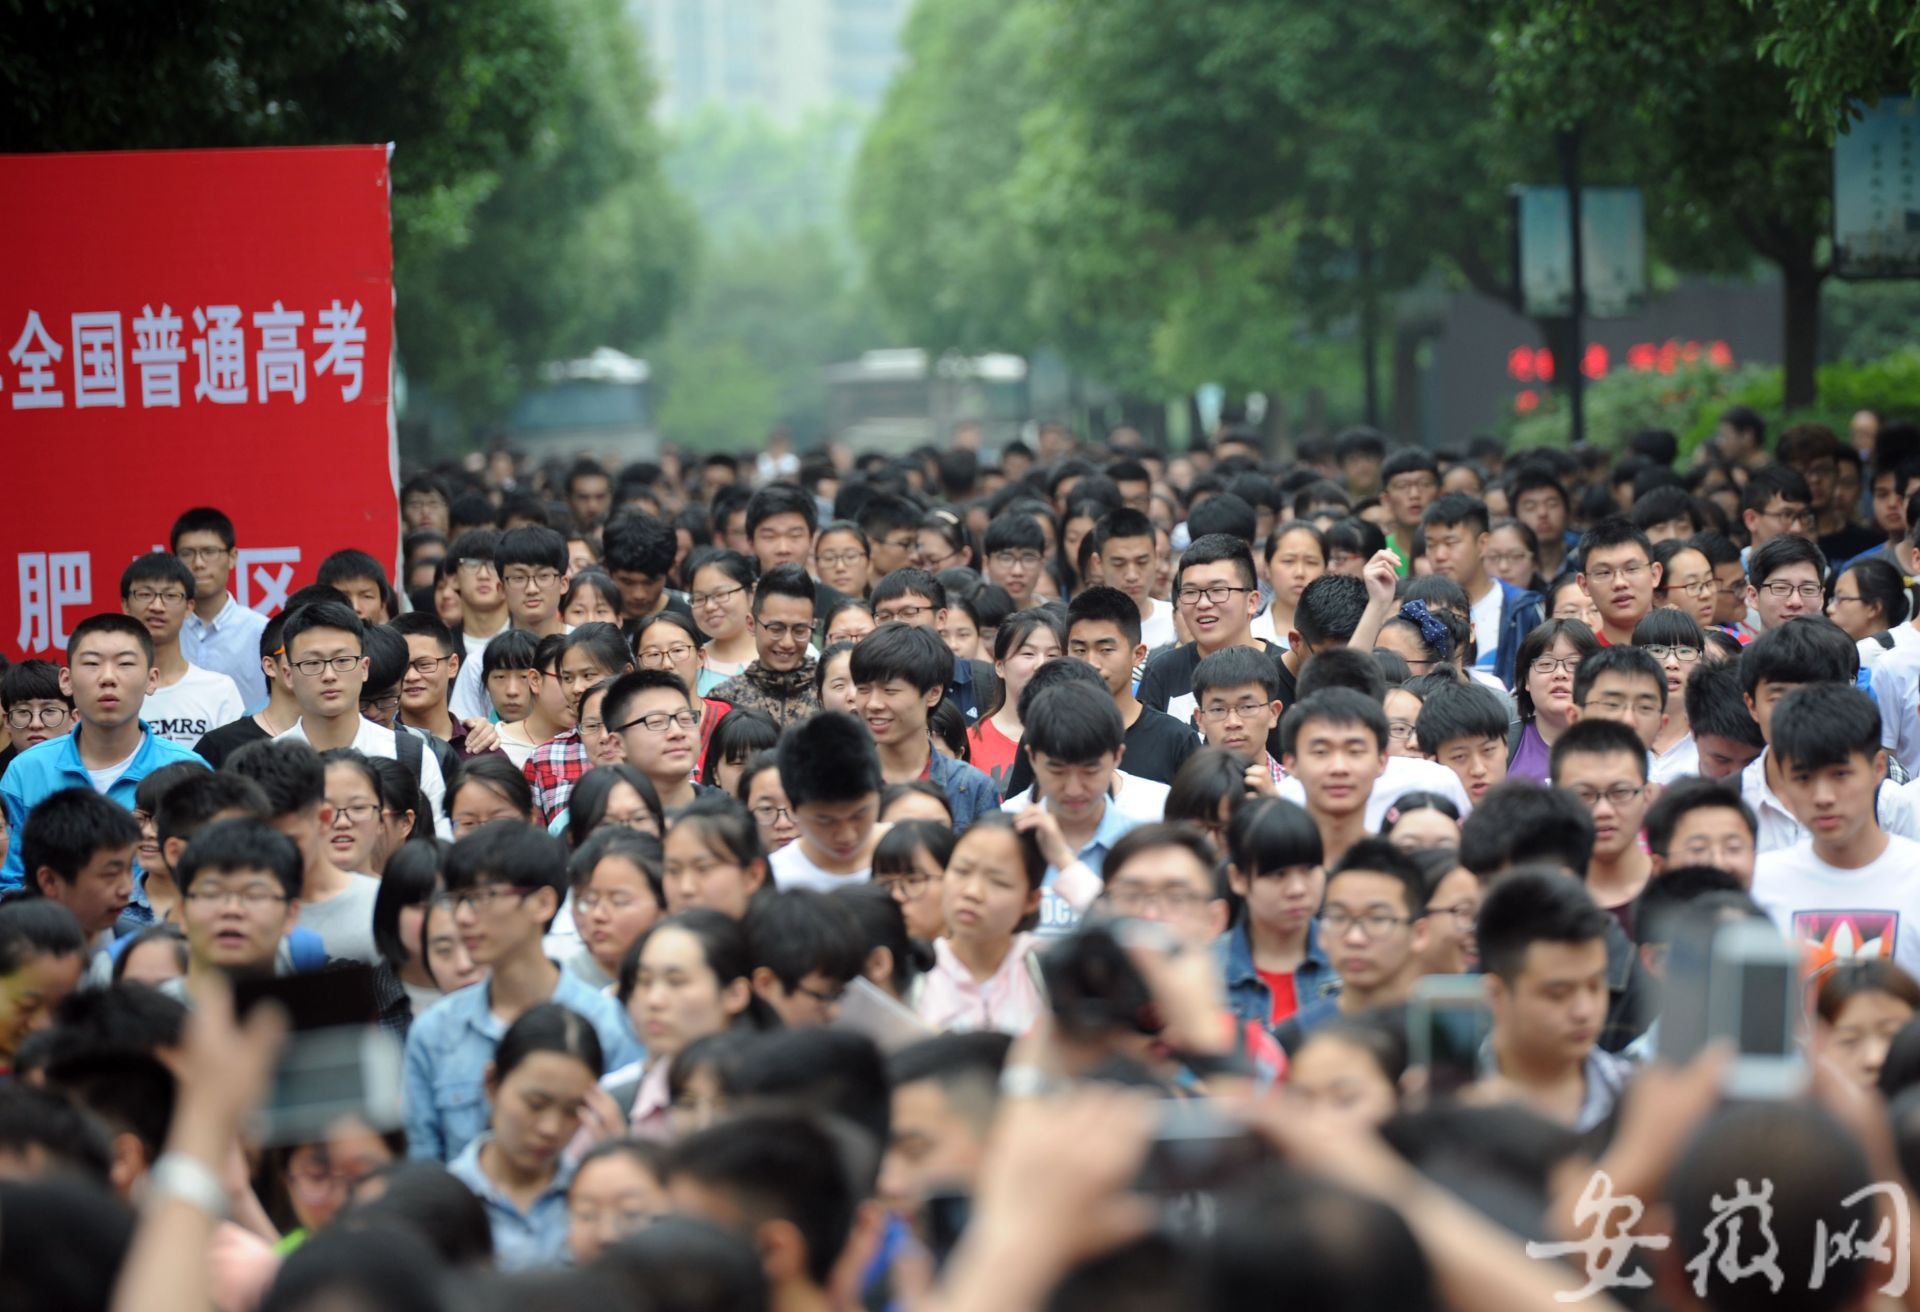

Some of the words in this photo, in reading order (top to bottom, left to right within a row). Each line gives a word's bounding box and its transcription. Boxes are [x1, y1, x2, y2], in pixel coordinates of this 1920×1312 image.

[0, 299, 367, 410] 全国普通高考
[17, 545, 301, 654] 肥区
